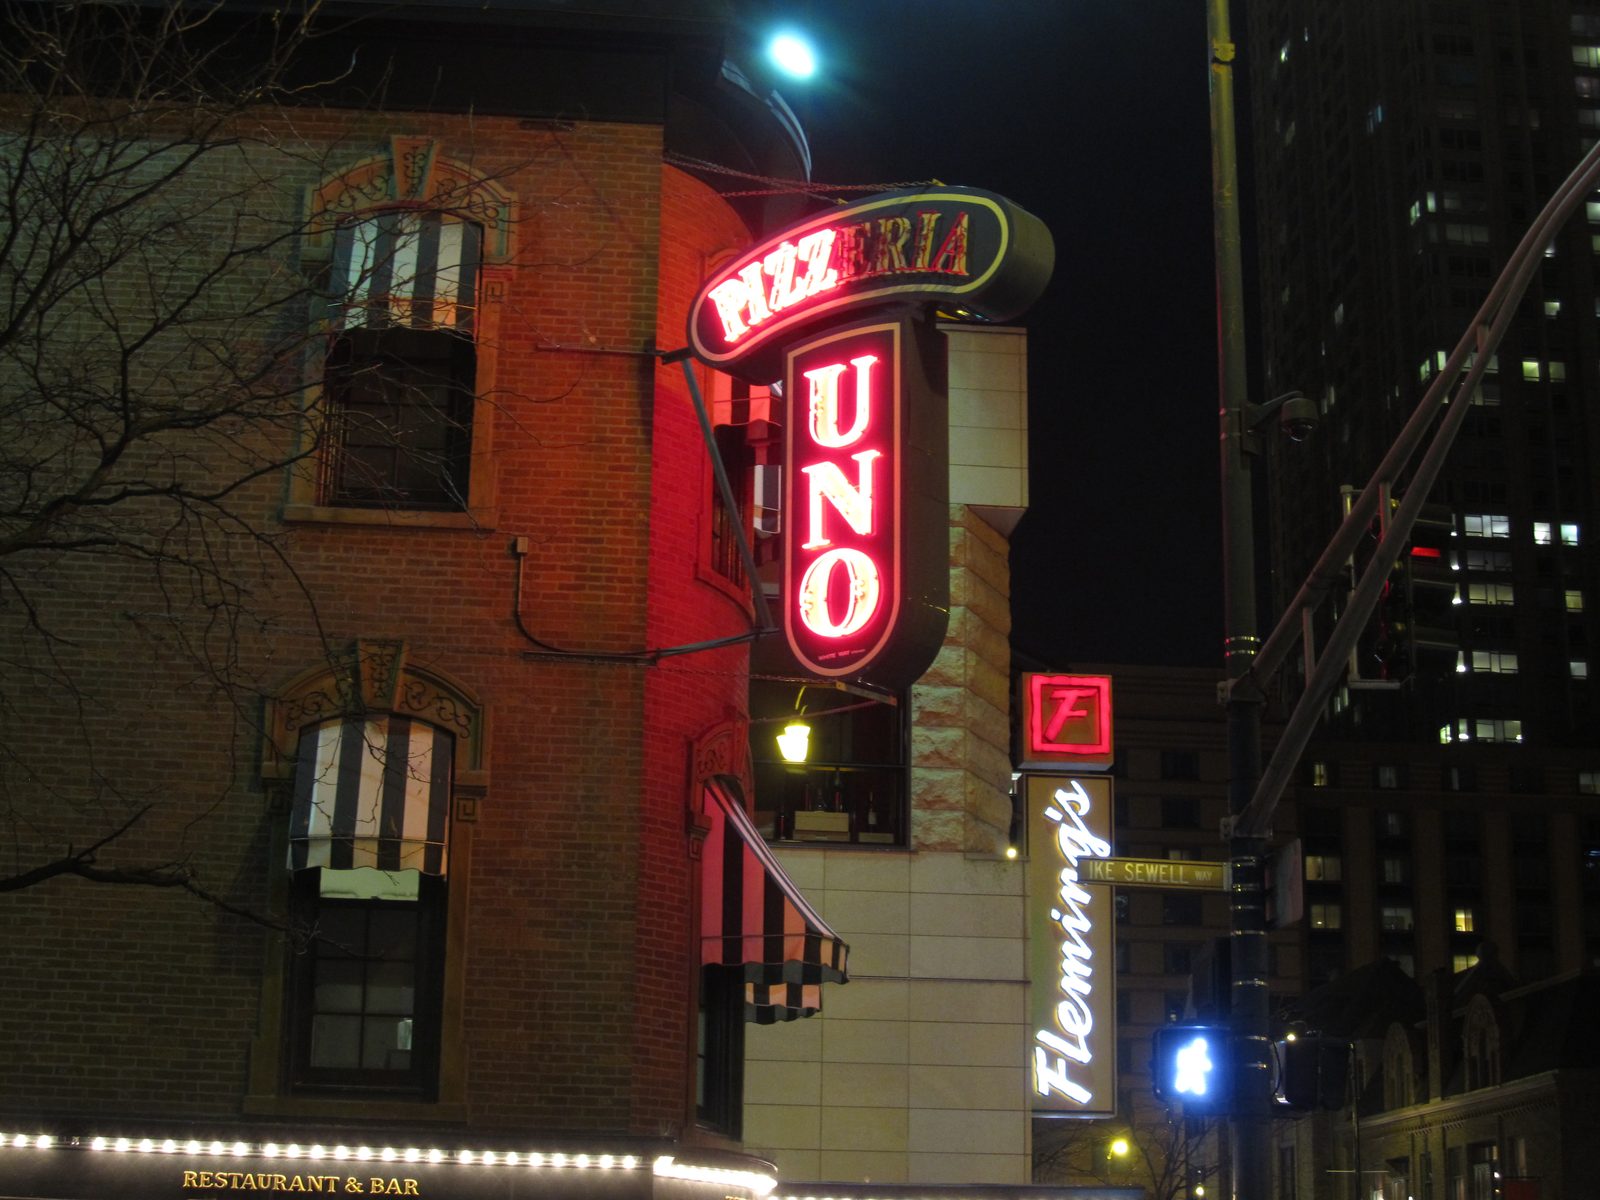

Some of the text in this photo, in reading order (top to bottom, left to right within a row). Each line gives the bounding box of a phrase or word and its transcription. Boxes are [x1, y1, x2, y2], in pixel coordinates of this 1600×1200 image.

[707, 210, 970, 343] PIZZERIA
[800, 354, 883, 639] UNO
[1045, 687, 1098, 741] F
[1089, 861, 1213, 884] IKE SEWELL WAY
[1034, 779, 1111, 1104] Fleming's
[183, 1170, 420, 1196] RESTAURANT & BAR
